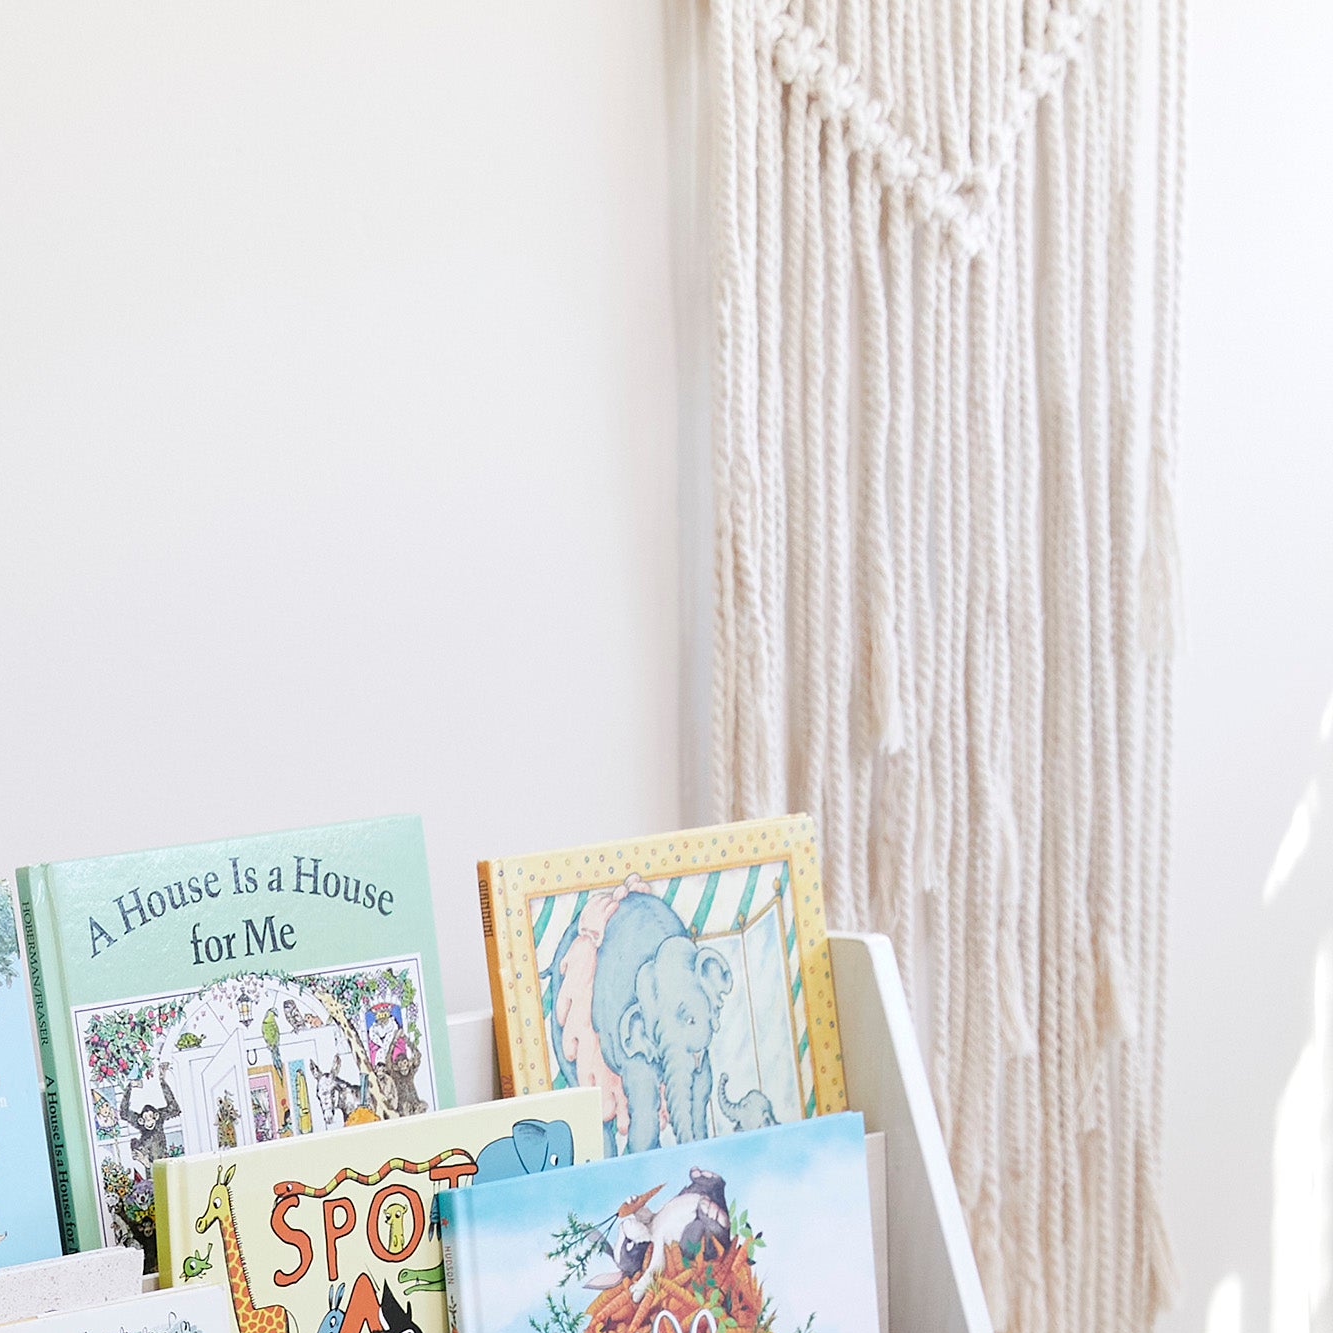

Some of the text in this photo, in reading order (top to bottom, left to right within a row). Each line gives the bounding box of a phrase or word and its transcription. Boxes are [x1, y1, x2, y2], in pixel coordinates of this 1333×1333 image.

[86, 856, 395, 958] A House Is a House
[190, 915, 297, 966] for Me
[45, 1075, 55, 1088] A
[47, 1092, 61, 1141] House
[54, 1143, 64, 1158] Is
[57, 1159, 64, 1167] a
[58, 1170, 72, 1219] House
[65, 1221, 77, 1244] for
[444, 1245, 455, 1285] HUDSON
